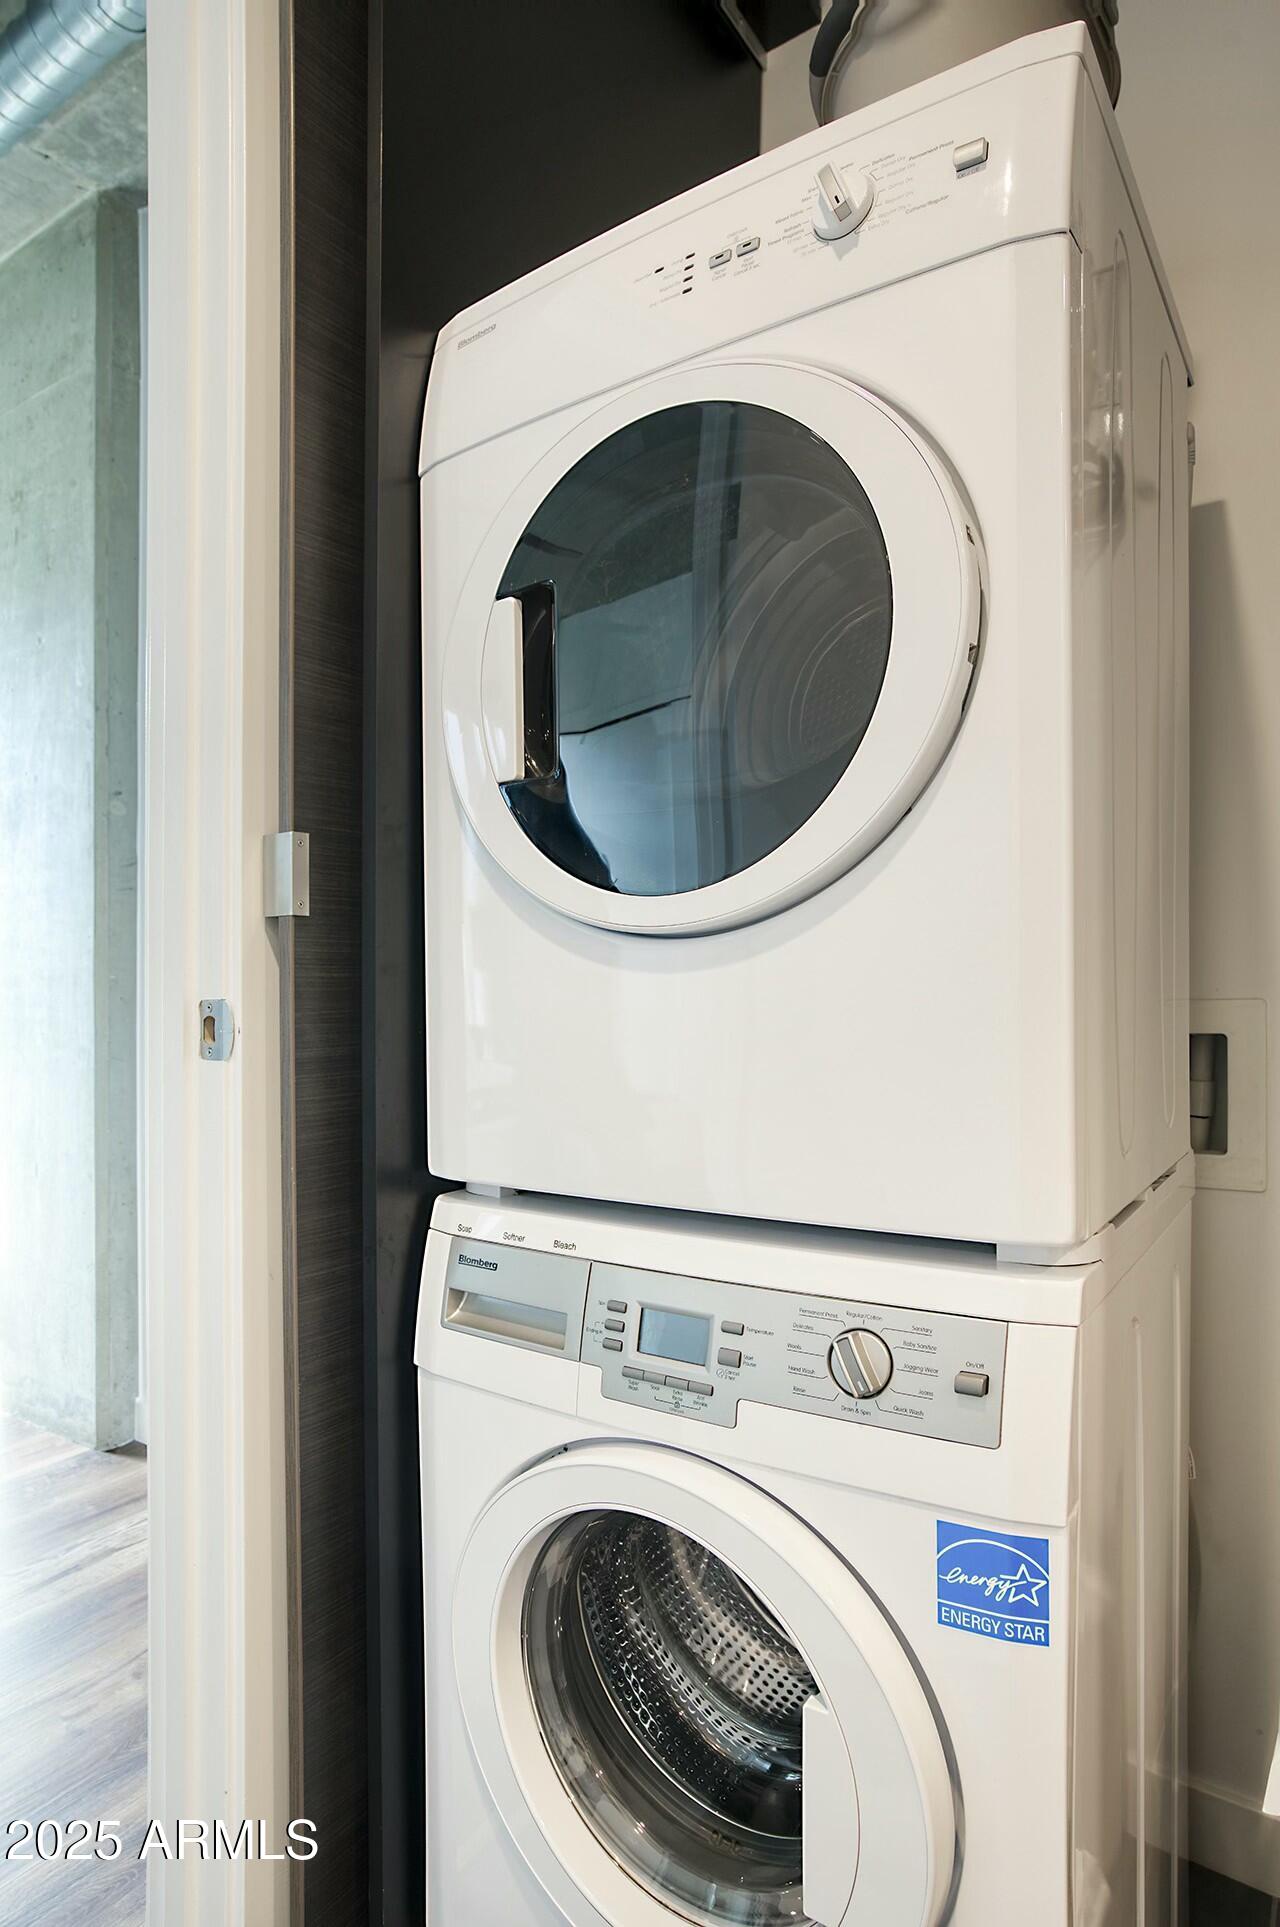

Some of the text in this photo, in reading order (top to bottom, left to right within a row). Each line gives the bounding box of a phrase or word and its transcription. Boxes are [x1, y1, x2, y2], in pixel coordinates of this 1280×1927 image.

[457, 1223, 577, 1251] Soap Softner Bleach
[458, 1253, 499, 1272] Blomberg
[902, 1340, 916, 1349] Baby
[788, 1364, 815, 1375] Hand Wash
[903, 1363, 939, 1374] Jogging Wear
[965, 1361, 985, 1370] On/Off
[841, 1404, 855, 1413] Drain
[860, 1408, 872, 1417] Spin
[893, 1405, 924, 1416] Quick Wash
[939, 1566, 1022, 1602] energy
[941, 1606, 1045, 1642] ENERGY STAR
